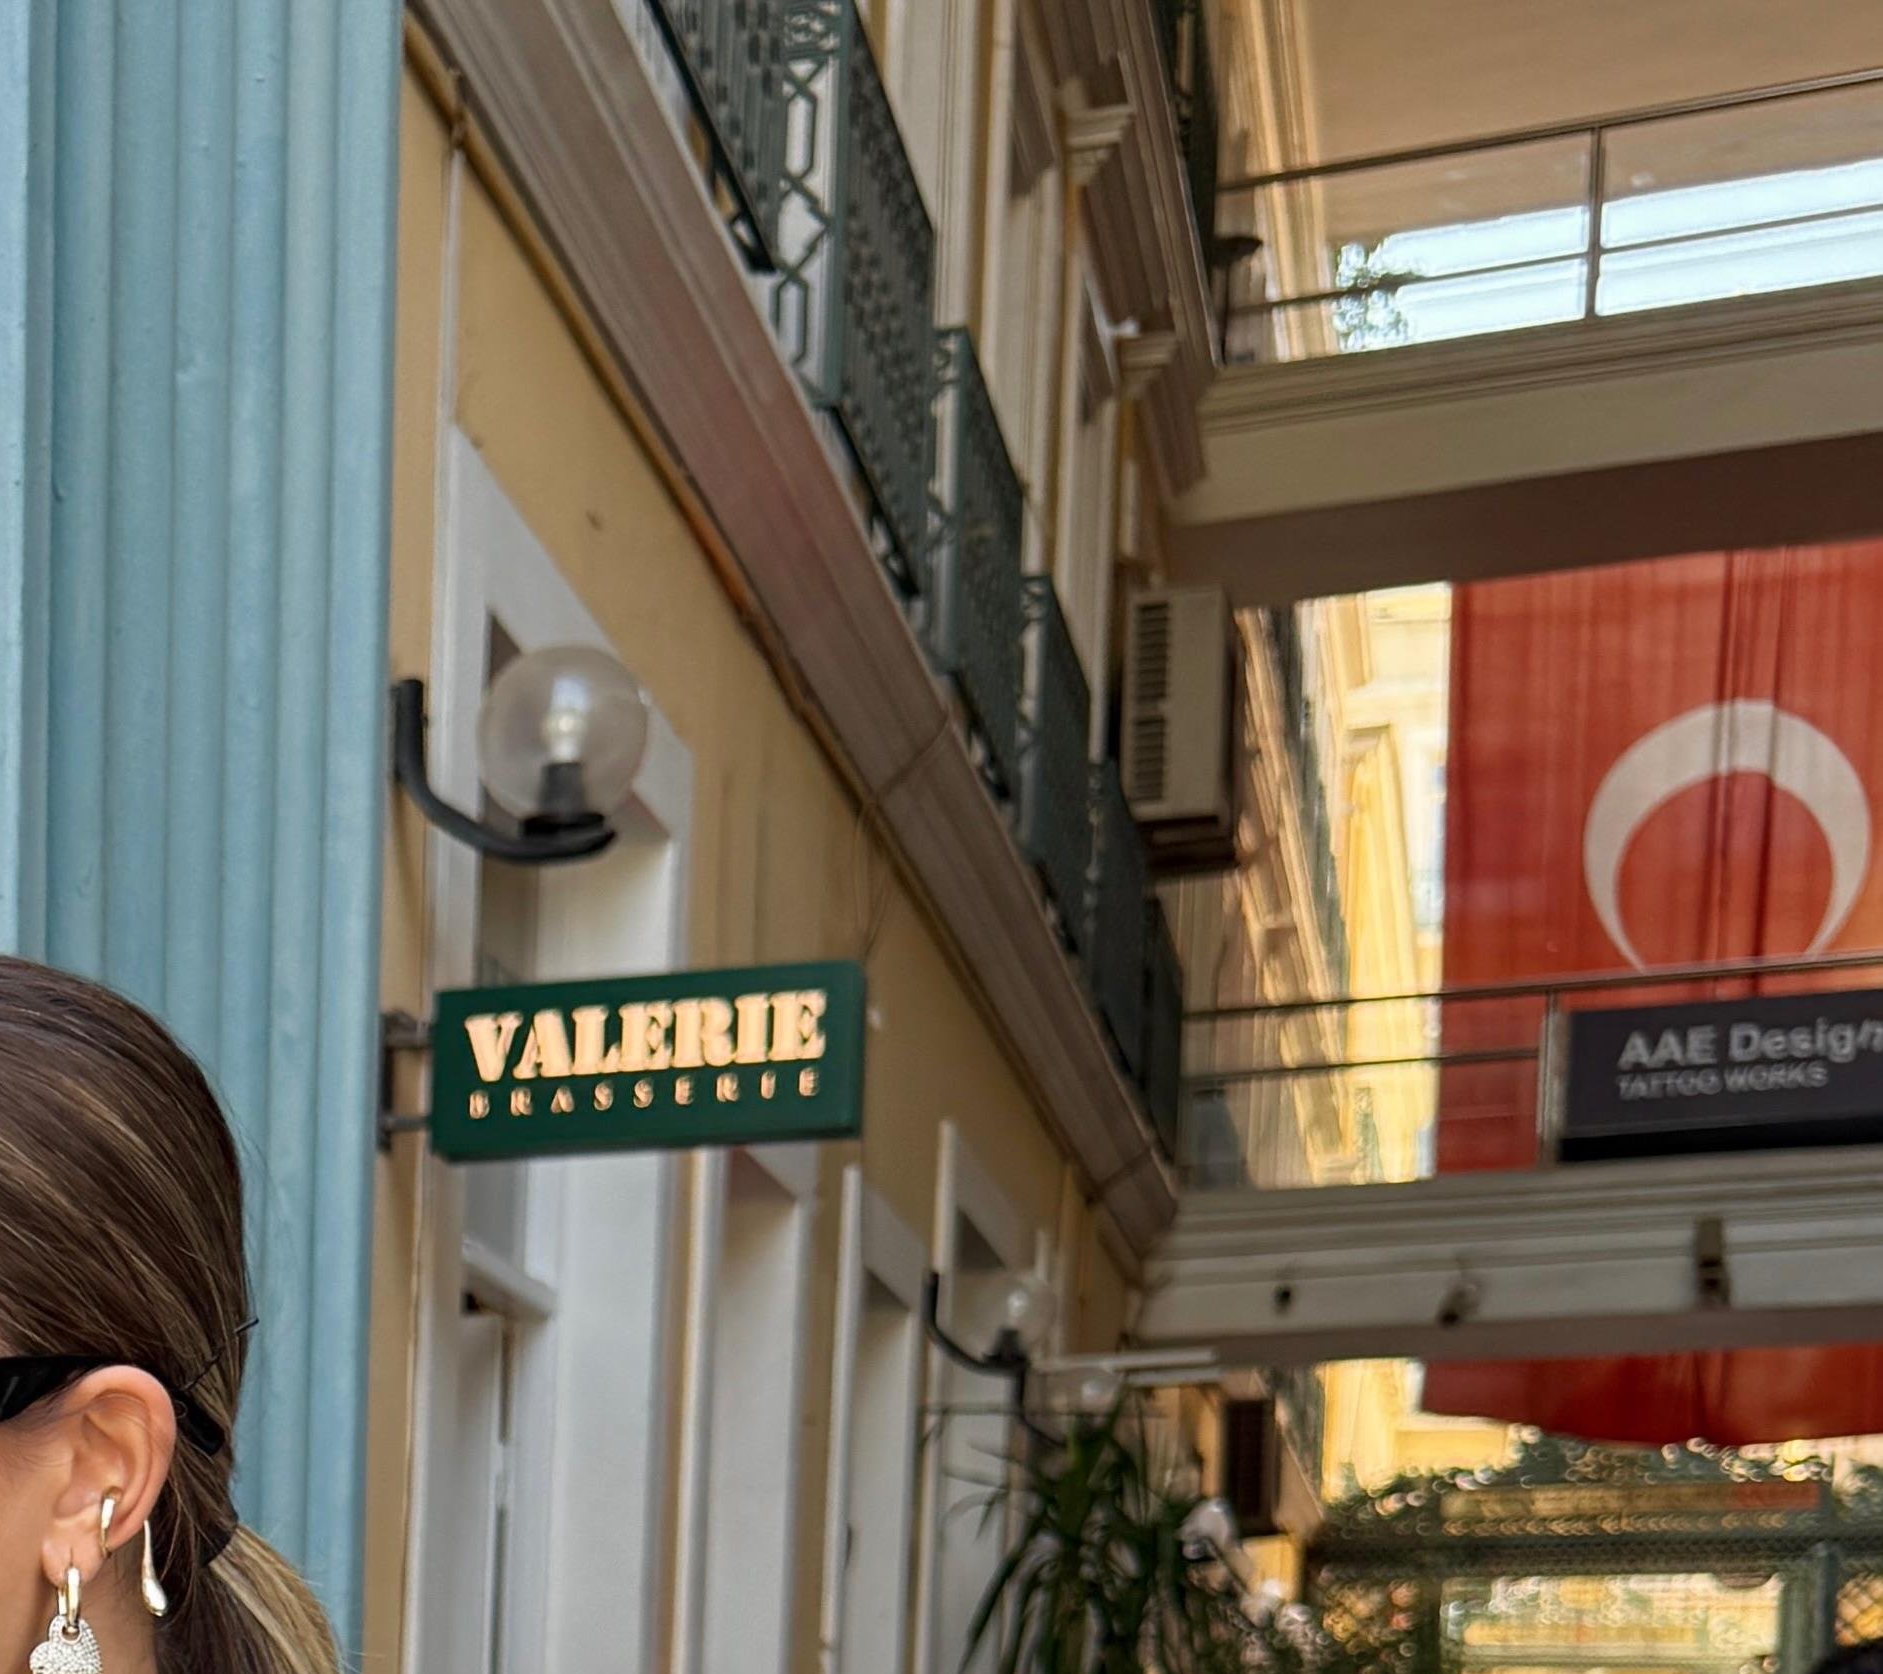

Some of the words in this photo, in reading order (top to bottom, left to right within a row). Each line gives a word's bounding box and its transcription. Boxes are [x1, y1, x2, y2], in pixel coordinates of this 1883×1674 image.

[465, 988, 827, 1082] VALERIE
[1617, 1025, 1717, 1070] AAE
[1728, 1016, 1883, 1063] Design
[468, 1067, 819, 1119] BRASSERIE
[1617, 1068, 1721, 1100] TATTOO
[1724, 1060, 1828, 1092] WORKS
